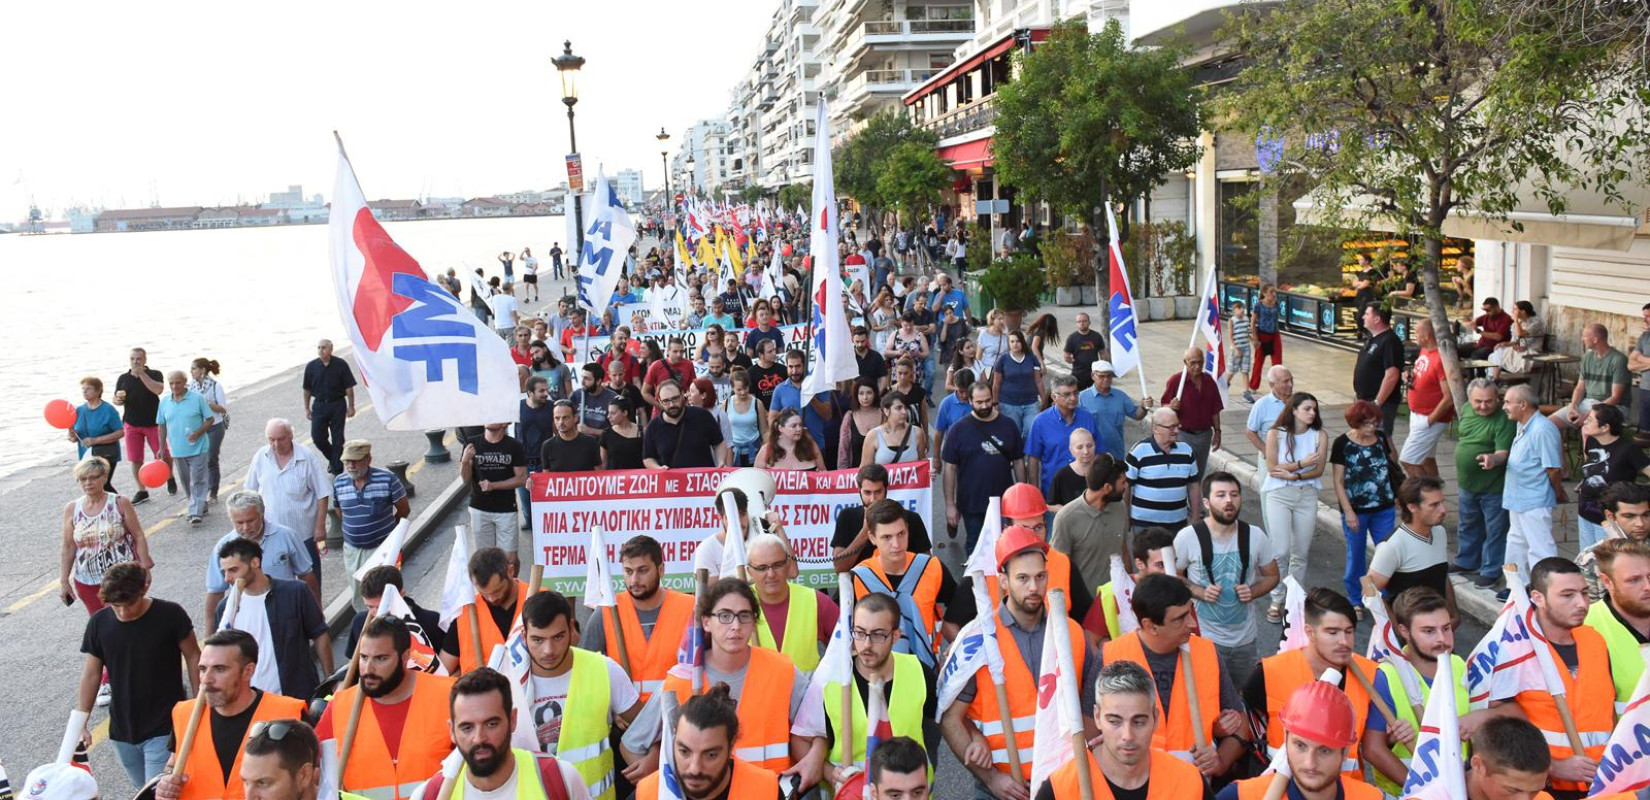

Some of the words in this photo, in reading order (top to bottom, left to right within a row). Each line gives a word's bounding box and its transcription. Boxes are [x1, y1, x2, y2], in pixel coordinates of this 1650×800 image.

[545, 475, 625, 497] ΑΠΑΙΤΟΥΜΕ
[628, 474, 658, 494] ΖΩΗ
[665, 479, 679, 493] ΜΕ
[816, 476, 831, 490] ΚΑΙ
[543, 511, 568, 534] ΜΙΑ
[793, 504, 830, 526] ΣΤΟΝ
[543, 545, 587, 566] ΤΕΡΜΑ
